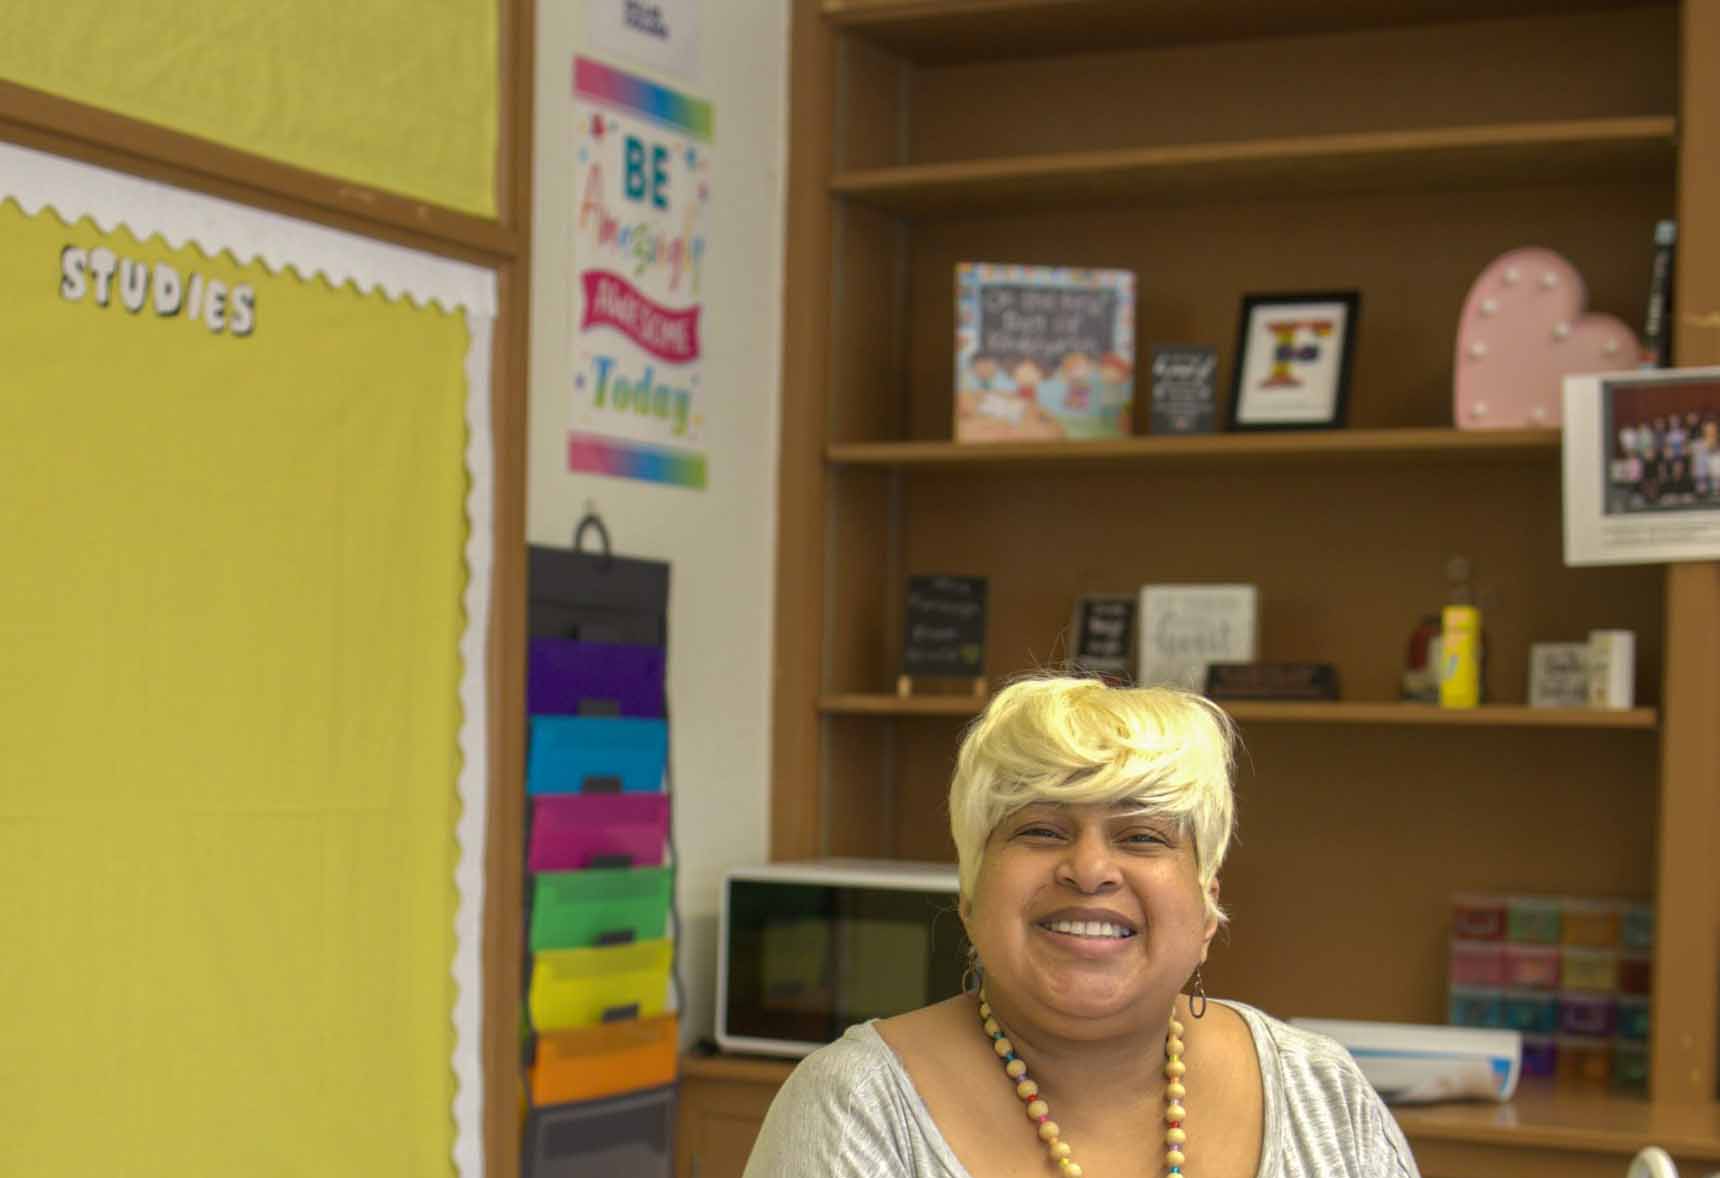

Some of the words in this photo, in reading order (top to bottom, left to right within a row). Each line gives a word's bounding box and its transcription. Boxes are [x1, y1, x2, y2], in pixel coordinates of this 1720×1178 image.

[622, 135, 669, 210] BE
[61, 245, 256, 336] STUDIES
[592, 278, 692, 354] AWESOME
[591, 355, 691, 438] Today
